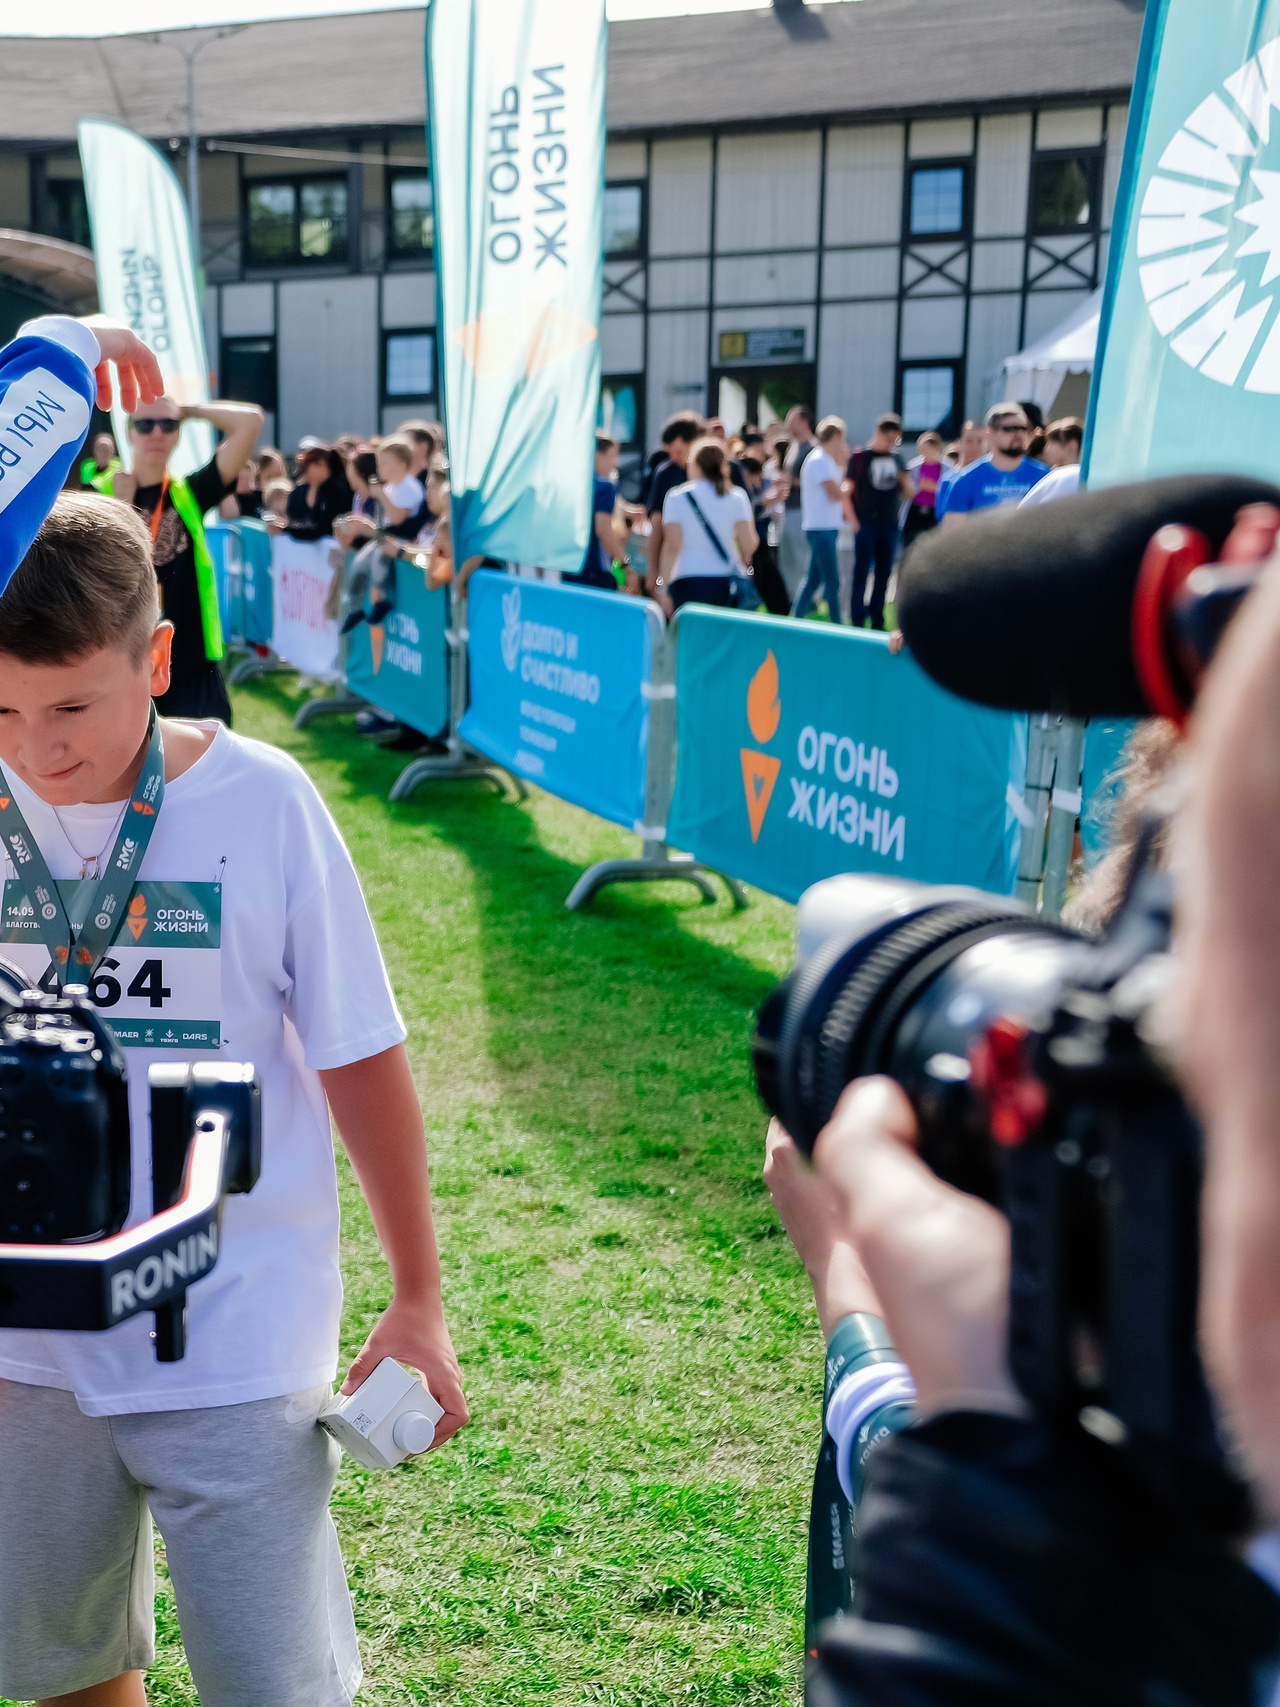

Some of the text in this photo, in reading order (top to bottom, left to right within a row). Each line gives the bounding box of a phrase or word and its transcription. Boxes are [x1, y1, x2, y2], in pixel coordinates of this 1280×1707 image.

[487, 85, 521, 264] ОГОНЬ
[531, 62, 569, 271] ЖИЗНИ
[6, 390, 66, 448] МЫ
[797, 725, 899, 798] ОГОНЬ
[787, 776, 906, 862] ЖИЗНИ
[5, 921, 41, 930] БЛАГОТВ
[153, 921, 209, 933] ЖИЗНИ
[156, 909, 205, 921] ОГОНЬ
[113, 1031, 139, 1039] MAER
[182, 1033, 208, 1041] DARS
[110, 1221, 218, 1316] RONIN
